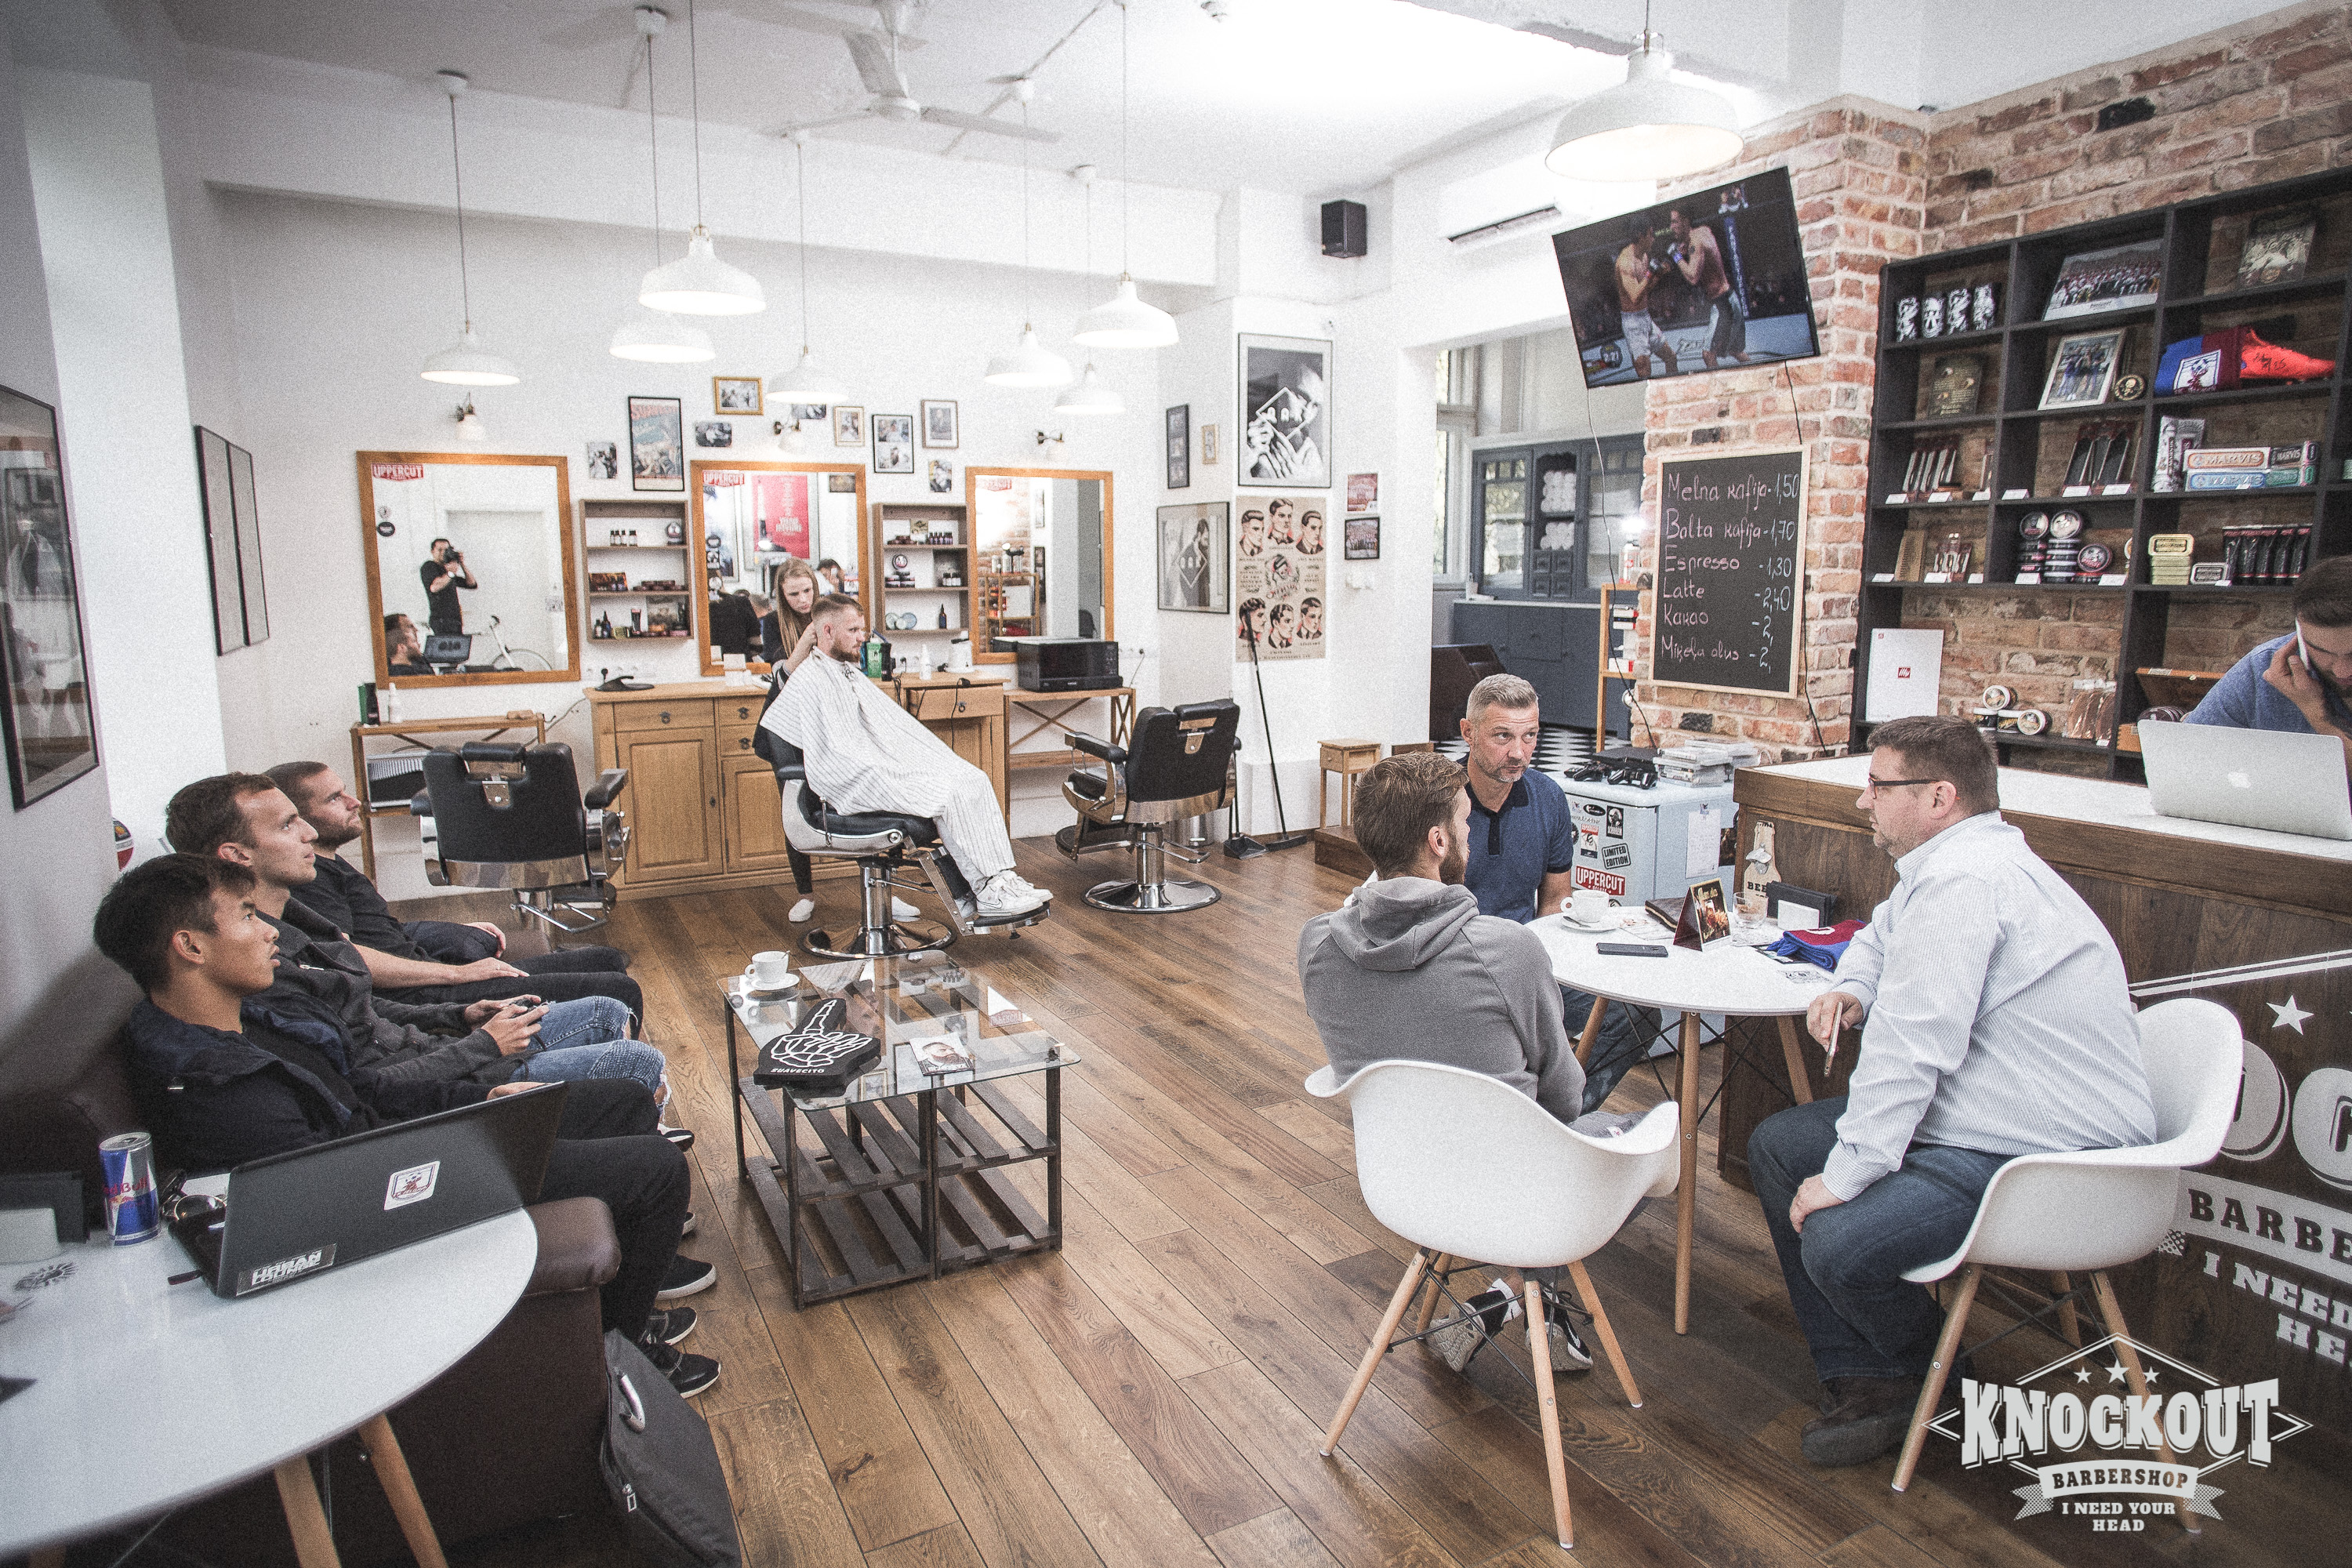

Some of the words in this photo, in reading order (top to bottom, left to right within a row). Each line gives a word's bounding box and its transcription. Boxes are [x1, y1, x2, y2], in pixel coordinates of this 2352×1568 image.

[2206, 452, 2263, 464] MARVIS
[373, 464, 422, 478] UPPERCUT
[703, 473, 744, 485] UPPERCUT
[1668, 472, 1719, 502] Melna
[1727, 474, 1767, 514] kafija
[1665, 507, 1713, 540] Balta
[1724, 516, 1761, 550] kafija
[1664, 543, 1740, 576] Espresso
[1663, 576, 1705, 599] Latte
[1663, 603, 1709, 626] Kakao
[1711, 640, 1740, 662] alus
[1603, 845, 1627, 858] LIMITED
[1606, 855, 1628, 867] EDITION
[1577, 867, 1624, 895] UPPERCUT
[120, 1177, 148, 1193] Bull
[2203, 1250, 2221, 1279] I
